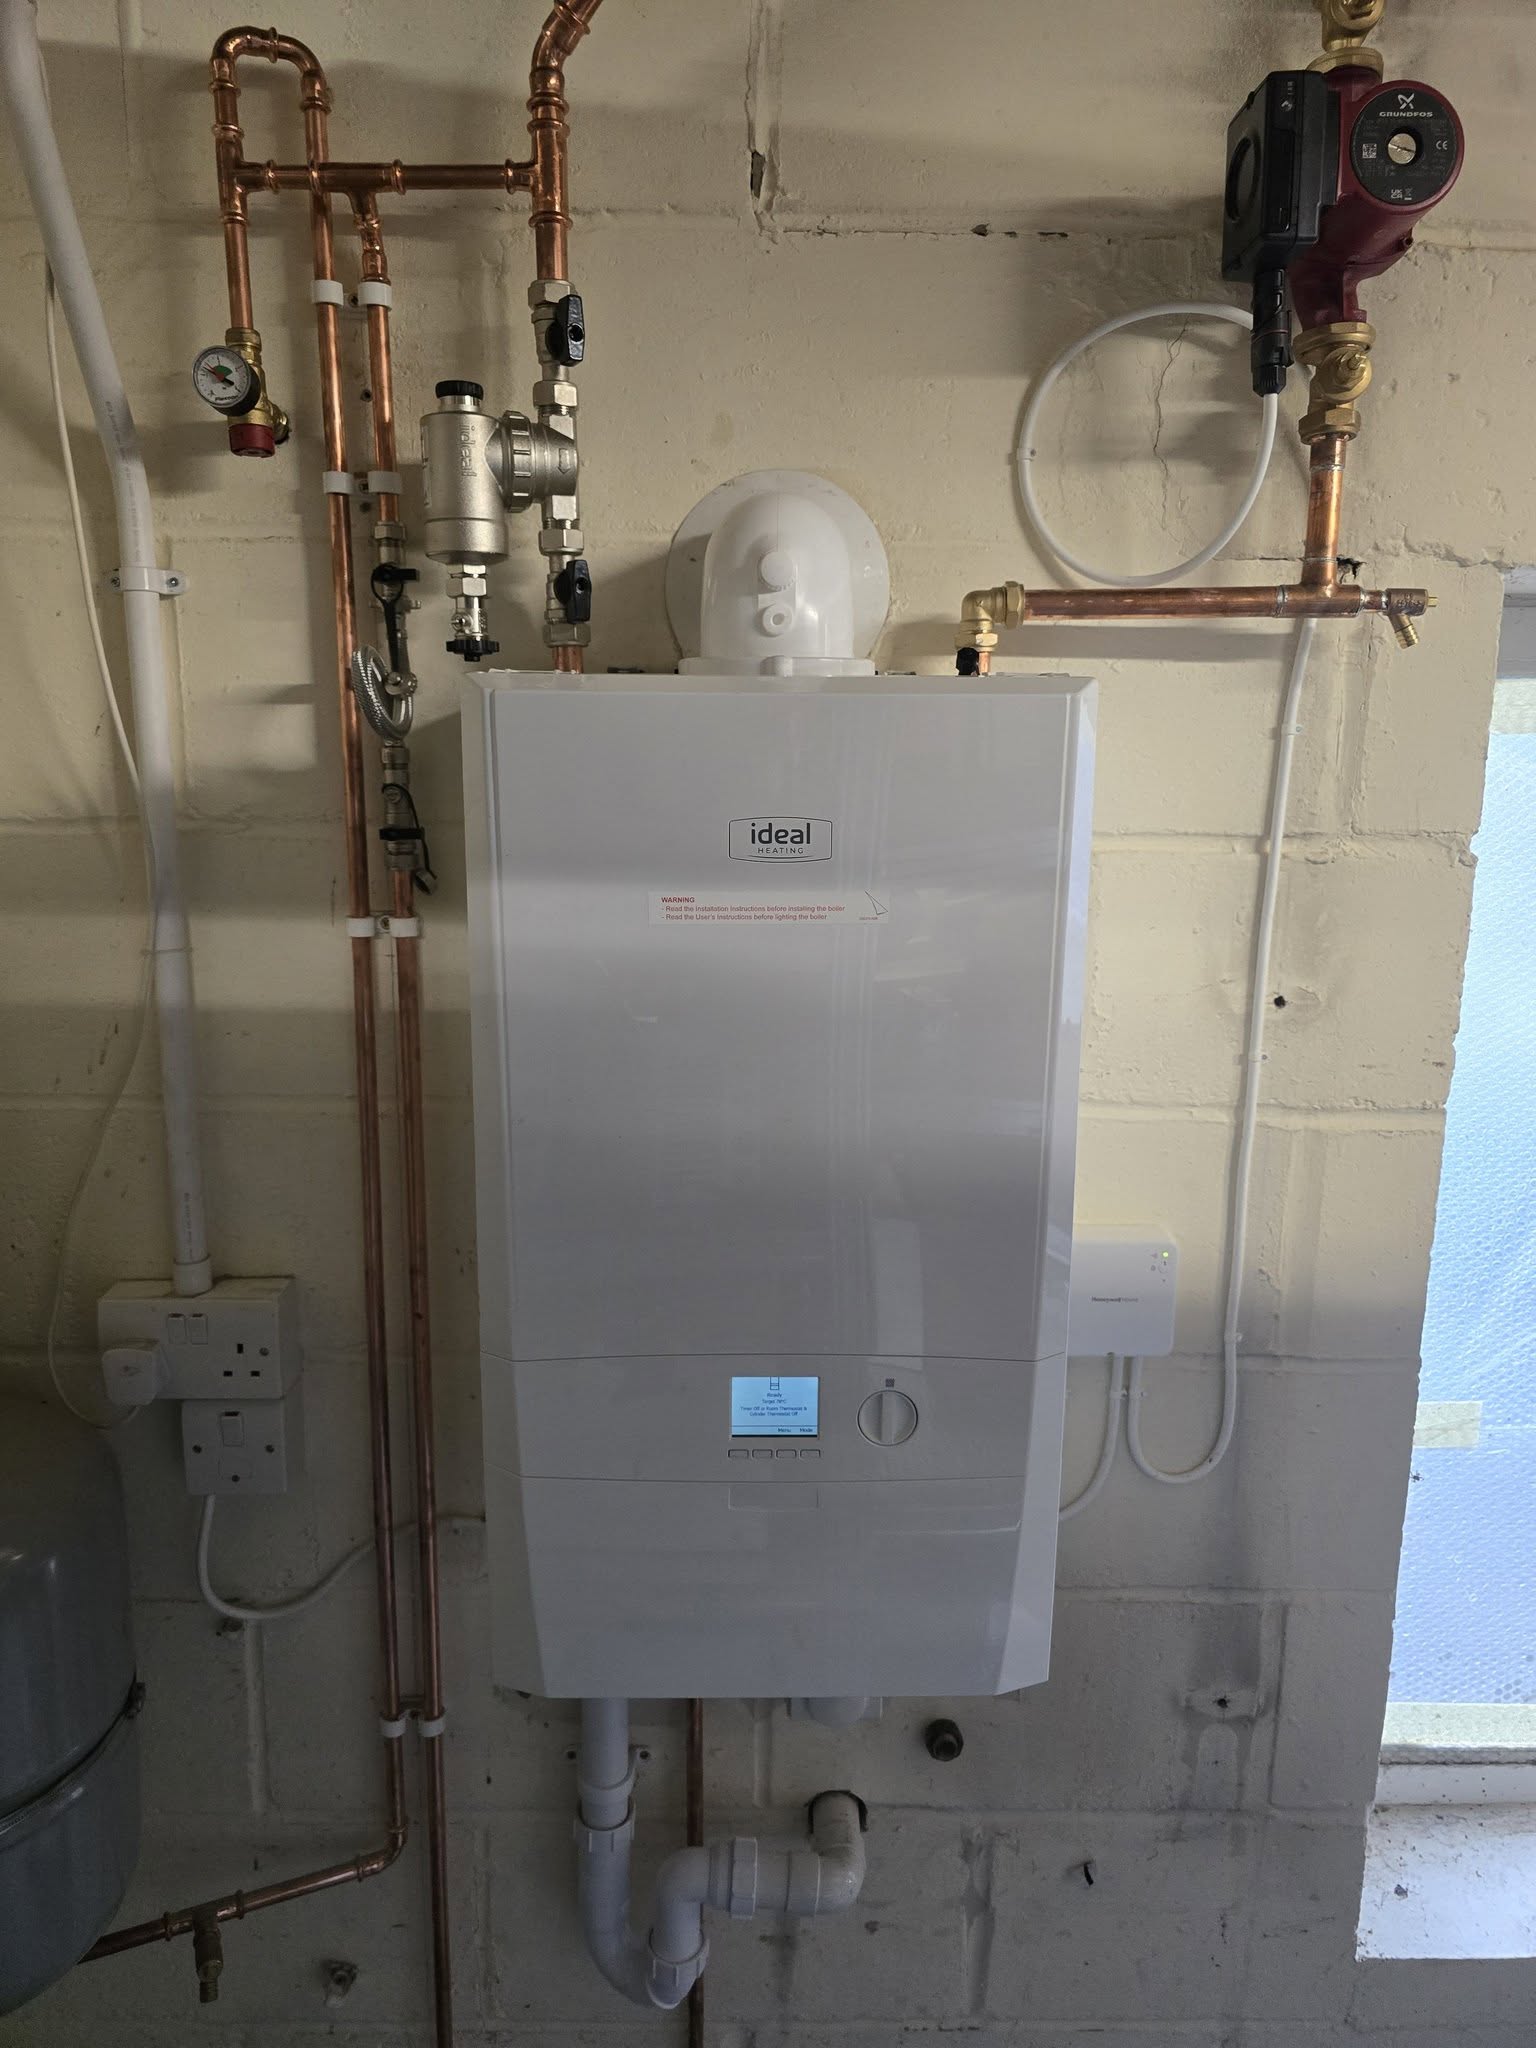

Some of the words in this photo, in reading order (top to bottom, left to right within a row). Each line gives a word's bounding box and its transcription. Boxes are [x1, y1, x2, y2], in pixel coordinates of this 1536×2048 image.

[459, 424, 477, 477] ideal
[751, 822, 811, 845] ideal
[788, 905, 815, 913] installing
